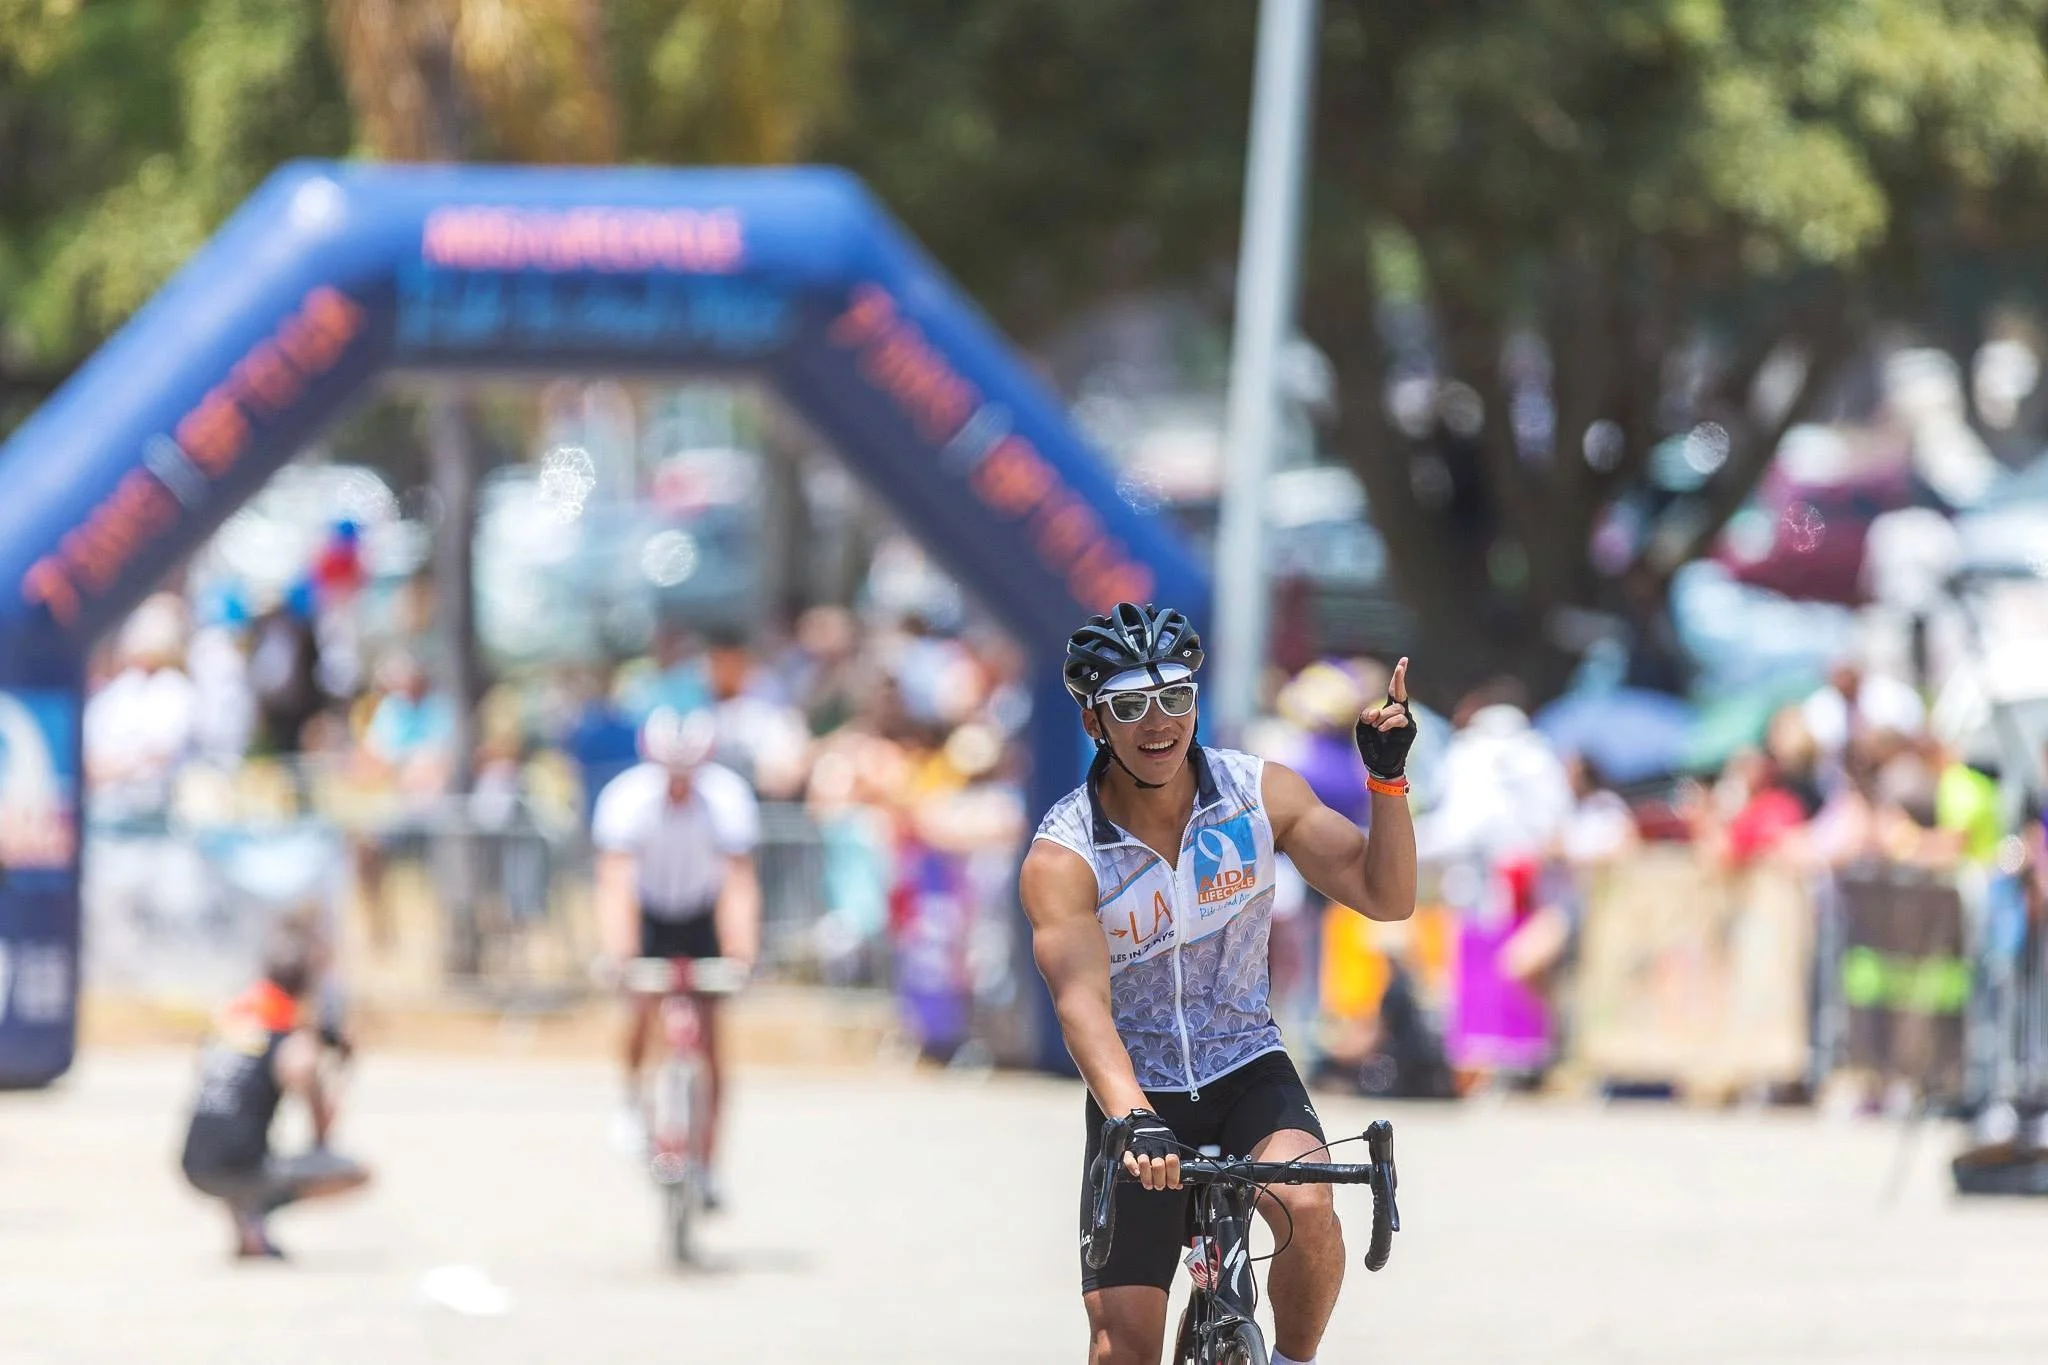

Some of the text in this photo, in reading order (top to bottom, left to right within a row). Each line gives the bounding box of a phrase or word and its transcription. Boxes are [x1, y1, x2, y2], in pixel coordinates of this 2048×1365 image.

[1129, 891, 1173, 944] LA
[1110, 953, 1127, 963] ILES
[1129, 949, 1142, 959] IN
